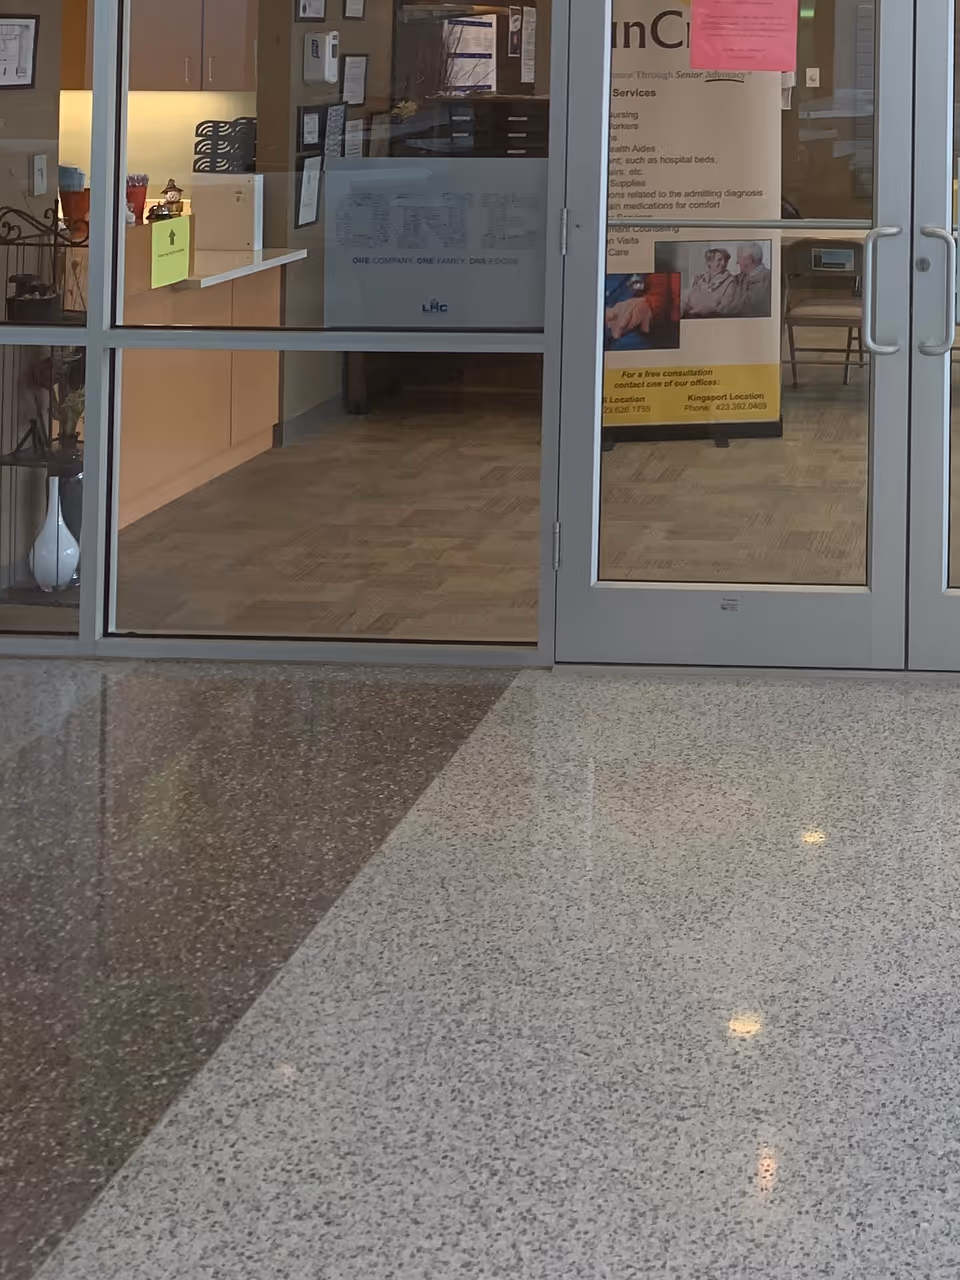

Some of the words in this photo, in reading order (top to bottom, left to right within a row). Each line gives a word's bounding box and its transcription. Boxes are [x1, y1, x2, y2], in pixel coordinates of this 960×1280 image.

[612, 88, 657, 98] Services
[609, 145, 631, 153] ealth
[625, 157, 645, 165] such
[660, 156, 693, 166] hospital
[627, 191, 656, 199] related
[669, 190, 682, 198] the
[683, 189, 722, 199] admitting
[724, 189, 763, 199] diagnosis
[623, 201, 673, 210] medications
[675, 201, 686, 209] for
[689, 201, 720, 209] comfort
[608, 248, 629, 256] Care
[422, 302, 448, 312] LHC
[621, 371, 636, 379] For
[644, 370, 661, 378] free
[662, 369, 713, 377] consultation
[614, 381, 645, 389] contact
[663, 380, 673, 388] of
[609, 396, 645, 404] Location
[687, 393, 728, 403] Kingsport
[730, 393, 764, 401] Location
